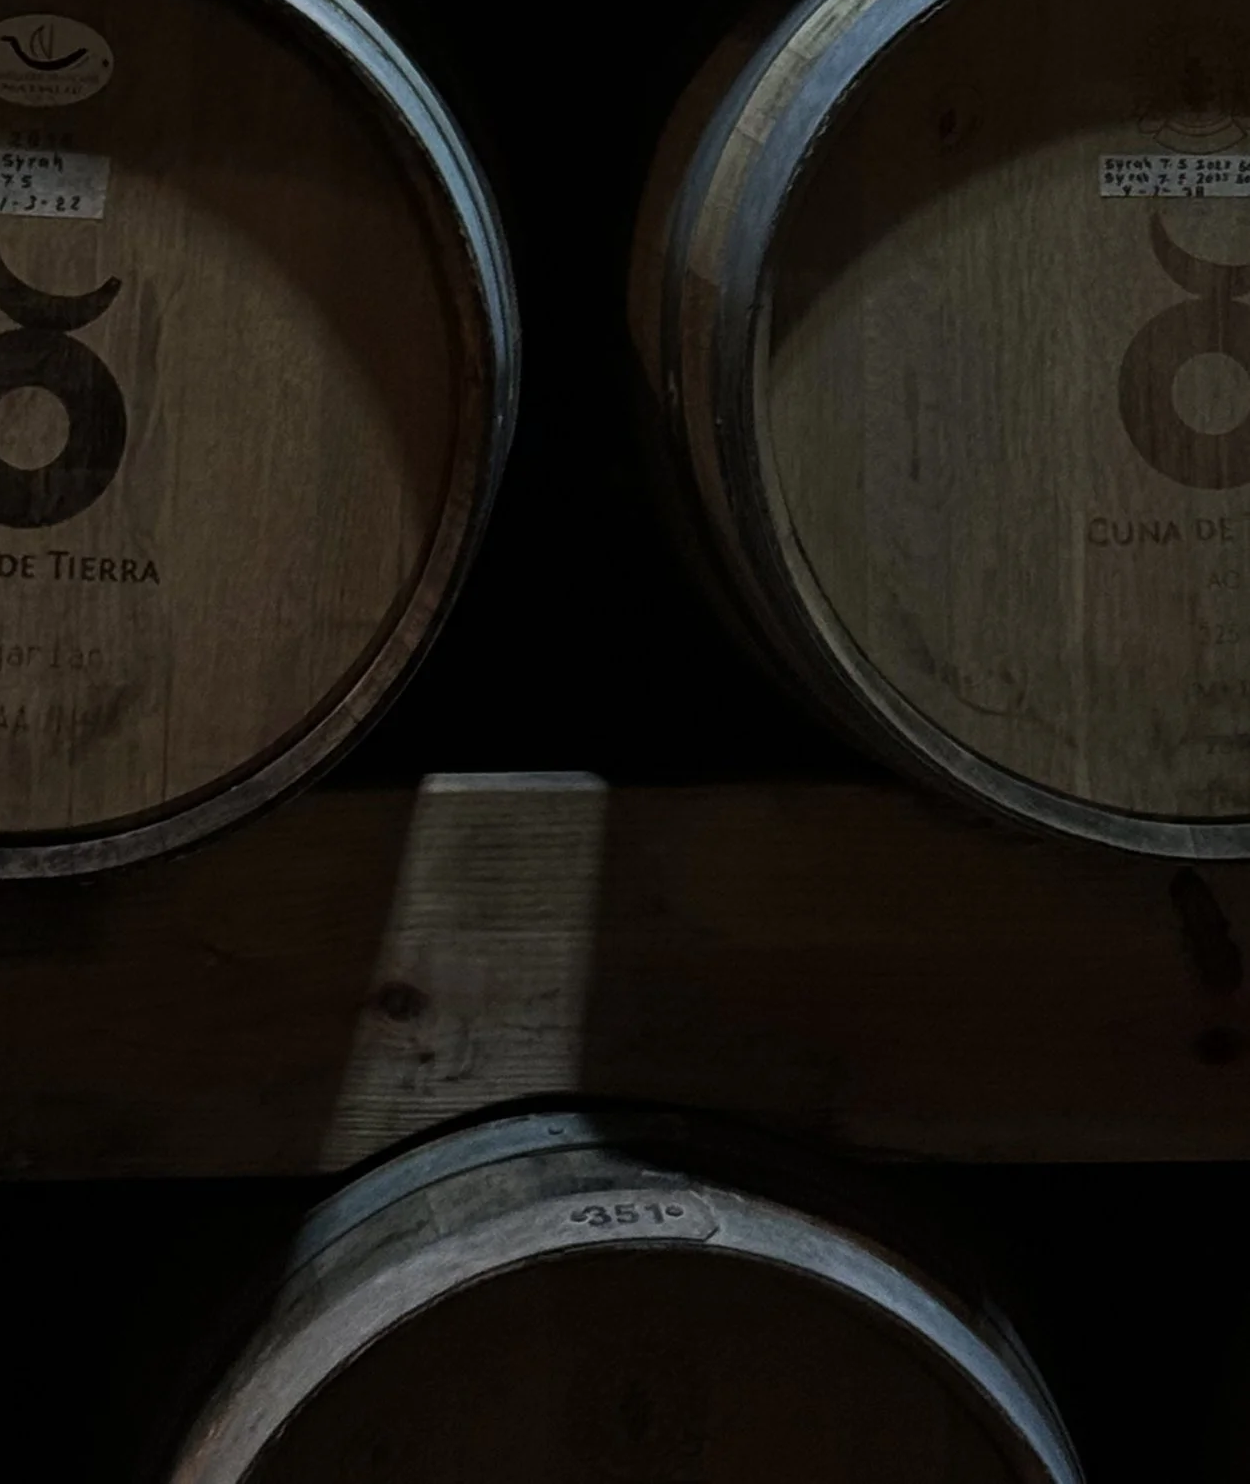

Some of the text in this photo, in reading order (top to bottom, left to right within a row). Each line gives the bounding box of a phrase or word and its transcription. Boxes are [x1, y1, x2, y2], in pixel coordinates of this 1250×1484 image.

[1087, 516, 1235, 548] CUNA DE
[47, 549, 162, 586] TIERRA
